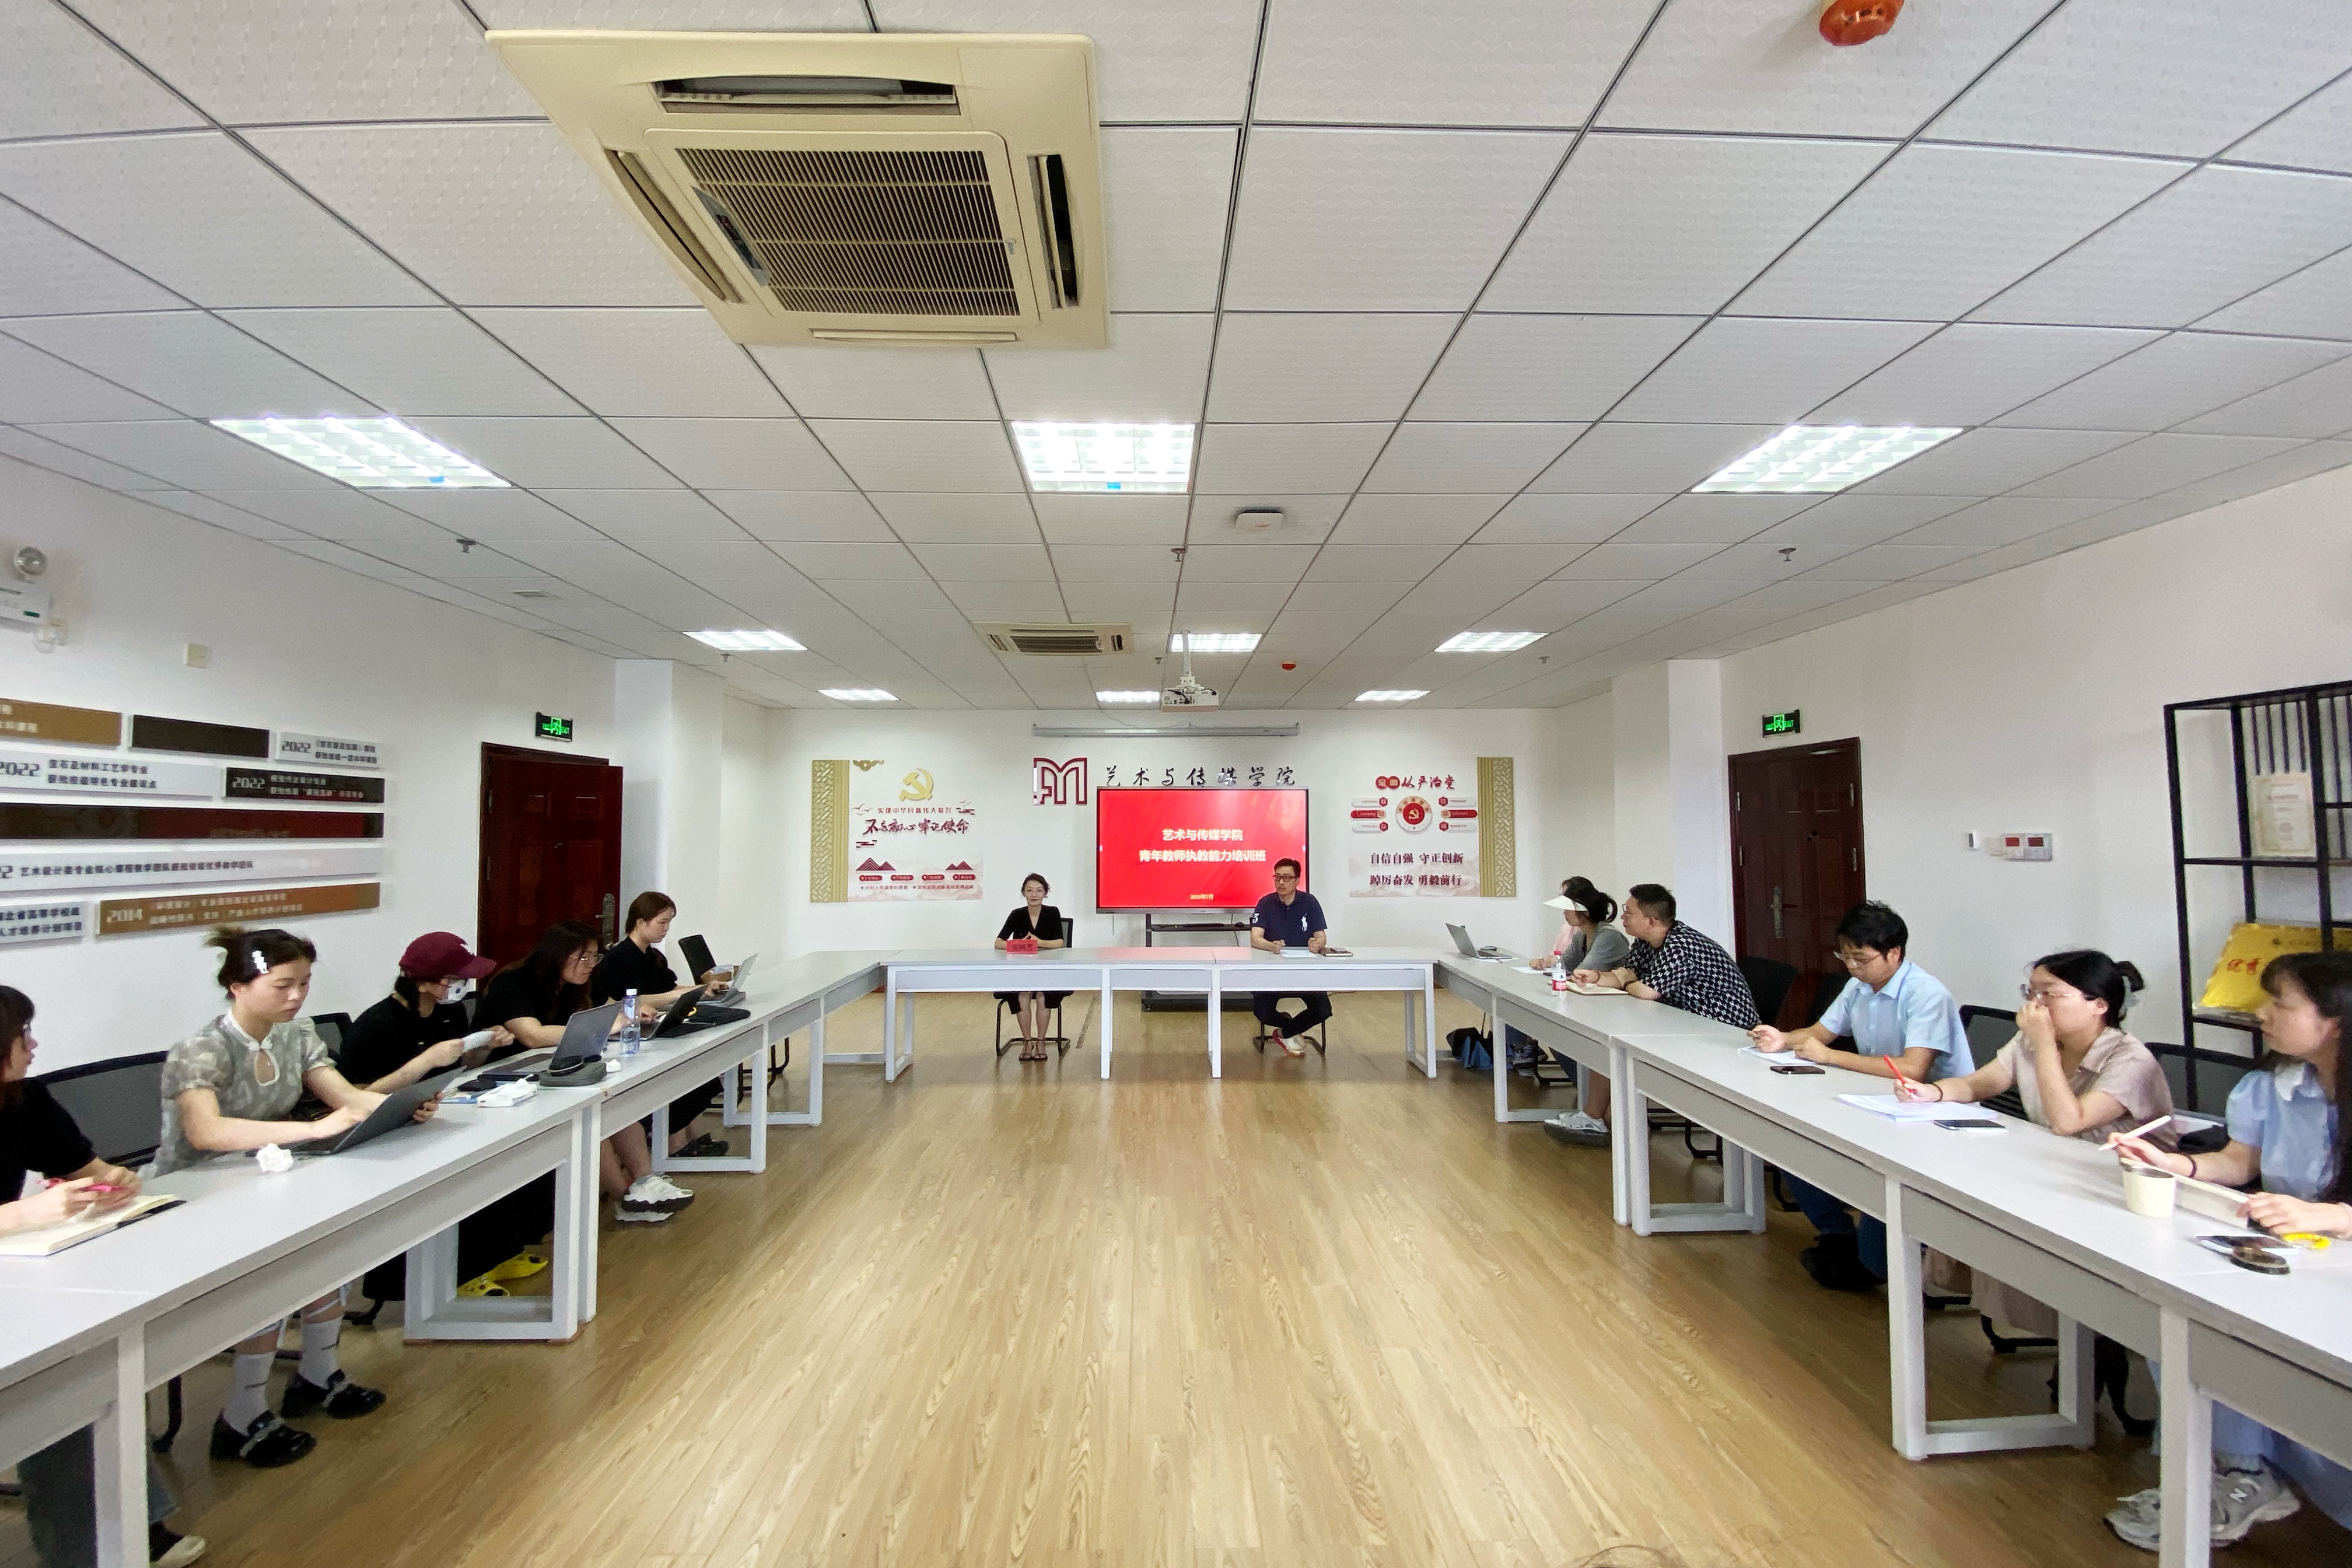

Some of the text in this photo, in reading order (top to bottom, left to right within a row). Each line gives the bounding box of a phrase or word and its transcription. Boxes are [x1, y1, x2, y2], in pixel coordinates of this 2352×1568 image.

[1107, 765, 1296, 786] 艺术与传媒学院
[1162, 828, 1244, 841] 艺术与传媒学院
[1139, 849, 1267, 863] 青年教师执教能力培训班
[1371, 853, 1464, 864] 自信自强 守正创新
[1370, 874, 1462, 886] 踔厉奋发 勇毅前行
[107, 908, 144, 923] 2014
